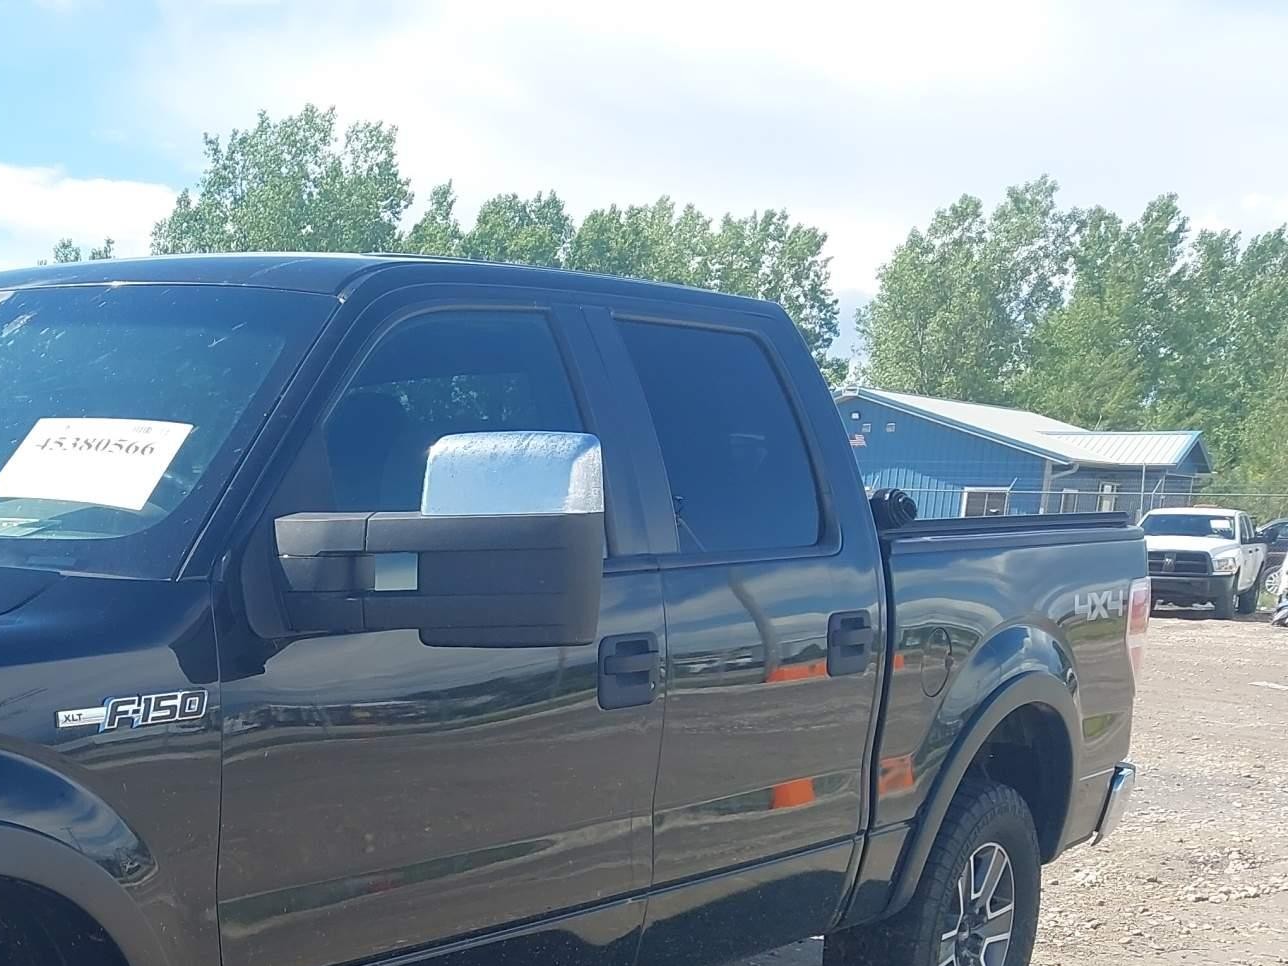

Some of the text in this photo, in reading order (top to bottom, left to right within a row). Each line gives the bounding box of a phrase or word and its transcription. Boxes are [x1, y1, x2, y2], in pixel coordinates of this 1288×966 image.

[35, 436, 156, 456] 45380566
[1074, 590, 1123, 620] 4X4
[63, 713, 84, 723] XLT
